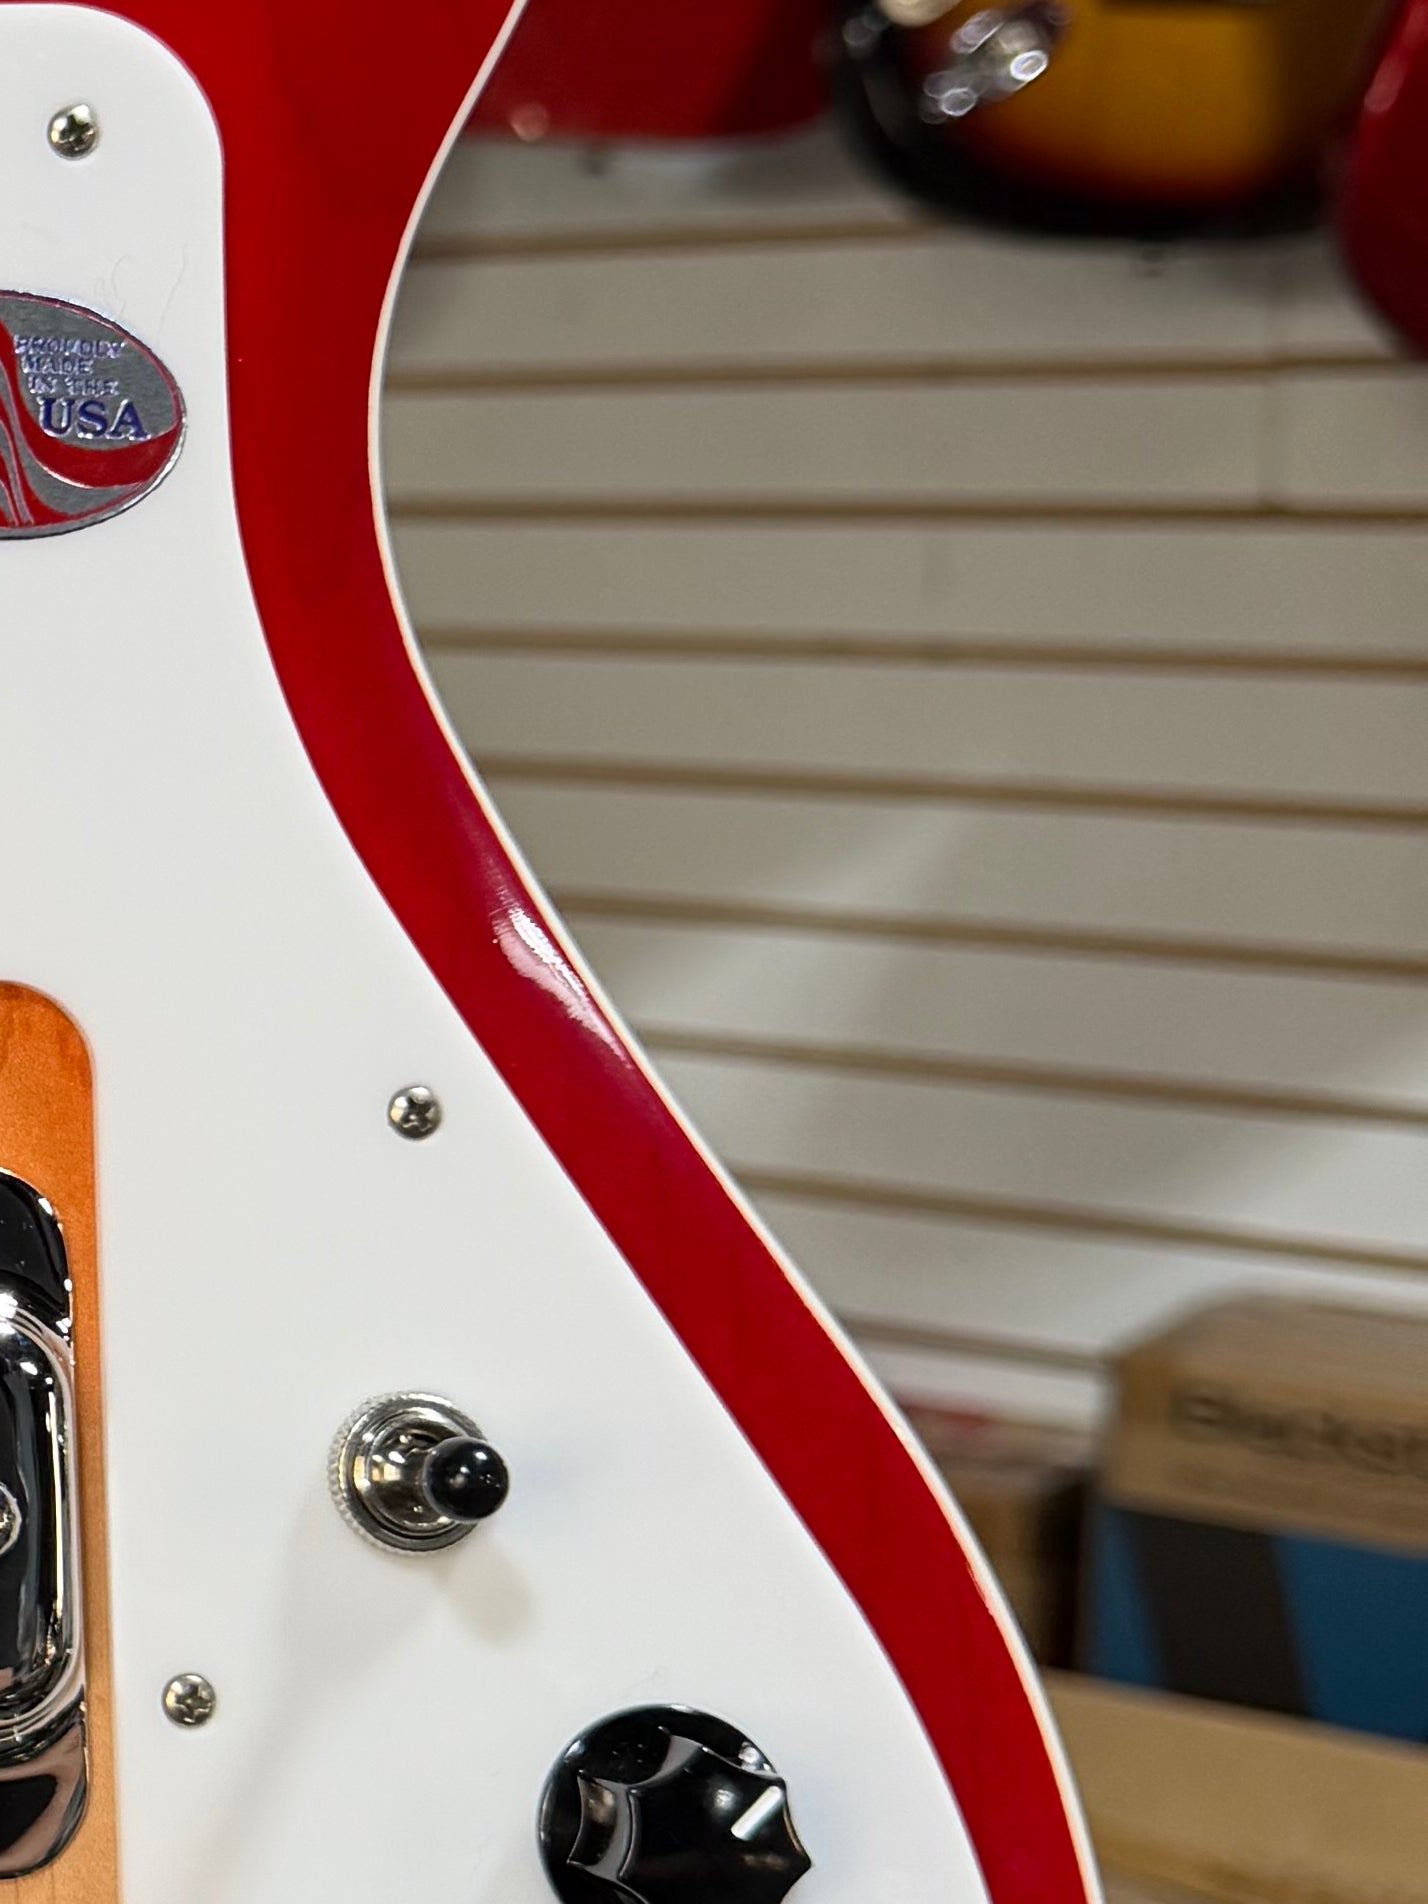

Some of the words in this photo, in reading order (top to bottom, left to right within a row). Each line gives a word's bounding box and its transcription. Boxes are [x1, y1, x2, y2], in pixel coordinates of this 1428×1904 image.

[13, 334, 126, 359] PROUDLY
[20, 355, 94, 375] MADE
[28, 375, 58, 394] IN
[64, 376, 120, 397] THE
[35, 396, 153, 442] USA
